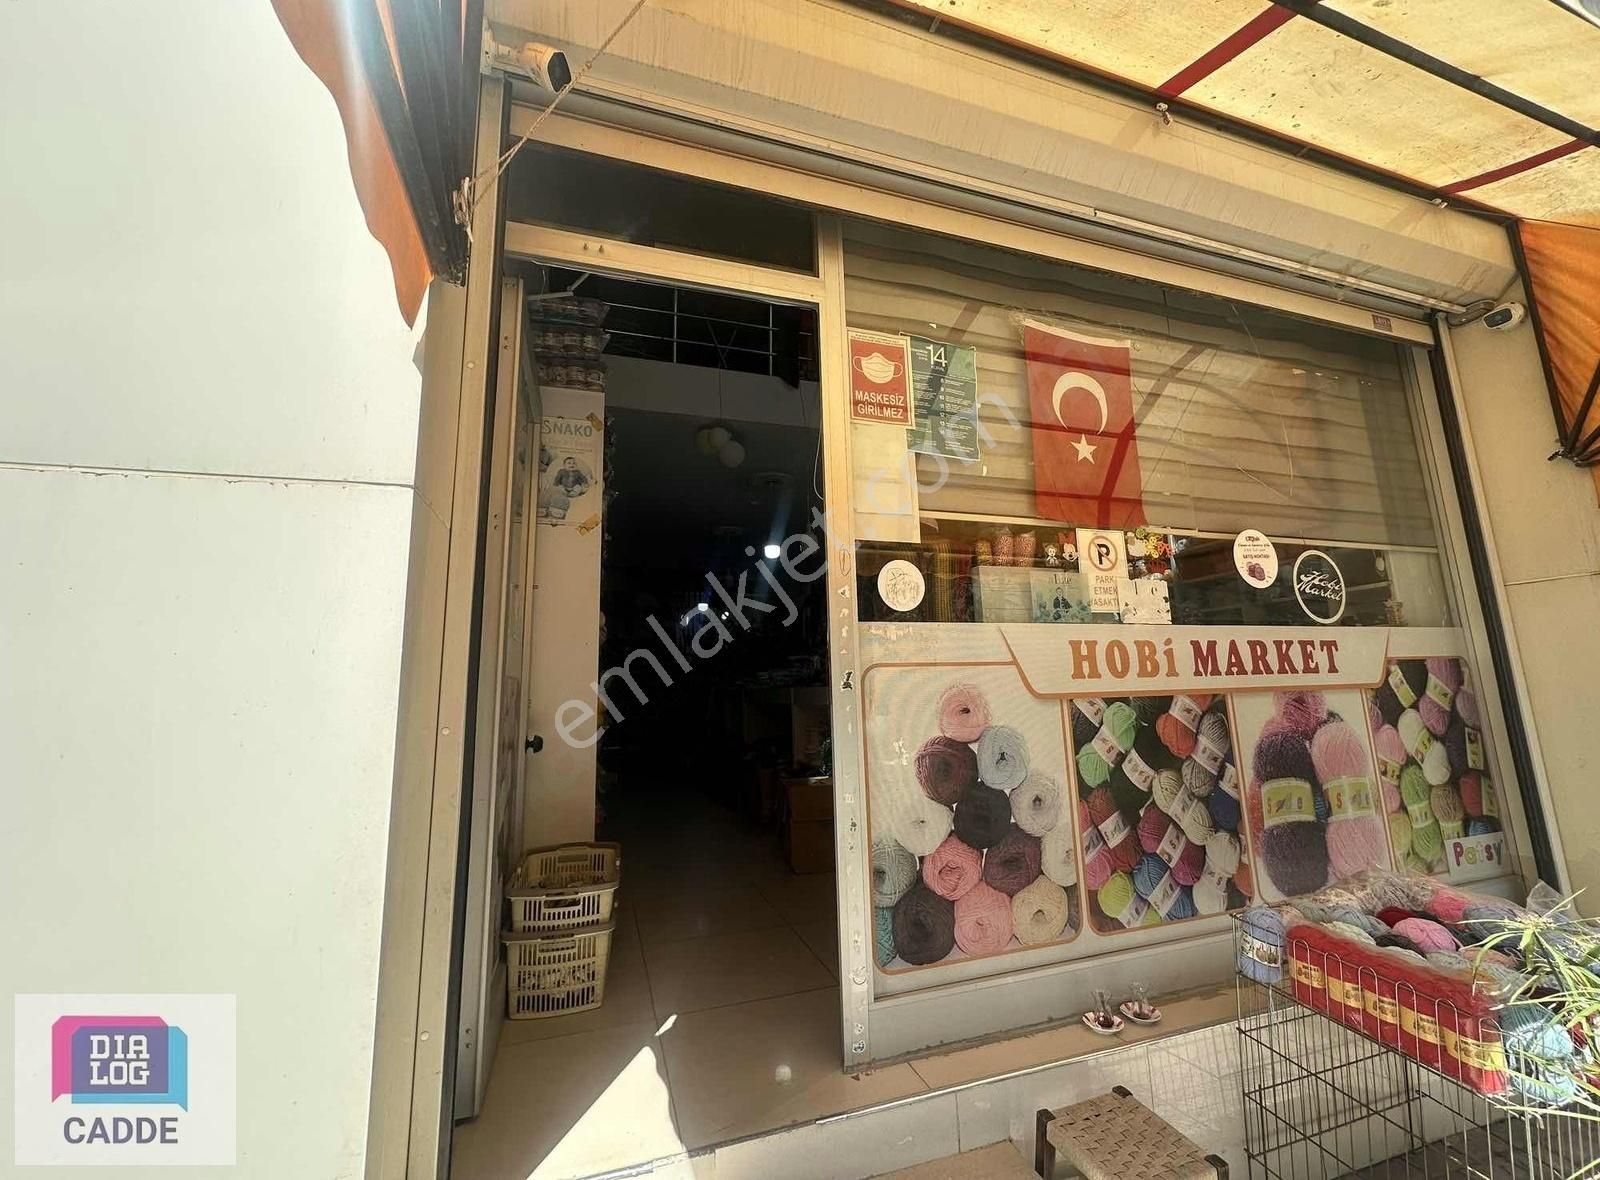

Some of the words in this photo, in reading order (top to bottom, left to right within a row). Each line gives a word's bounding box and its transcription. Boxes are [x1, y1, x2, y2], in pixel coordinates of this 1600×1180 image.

[925, 344, 947, 367] 14
[855, 390, 905, 406] MASKESİZ
[857, 403, 904, 419] GİRİLMEZ
[1095, 575, 1114, 584] PARK
[1093, 586, 1118, 596] ETMEK
[1189, 639, 1339, 677] MARKET
